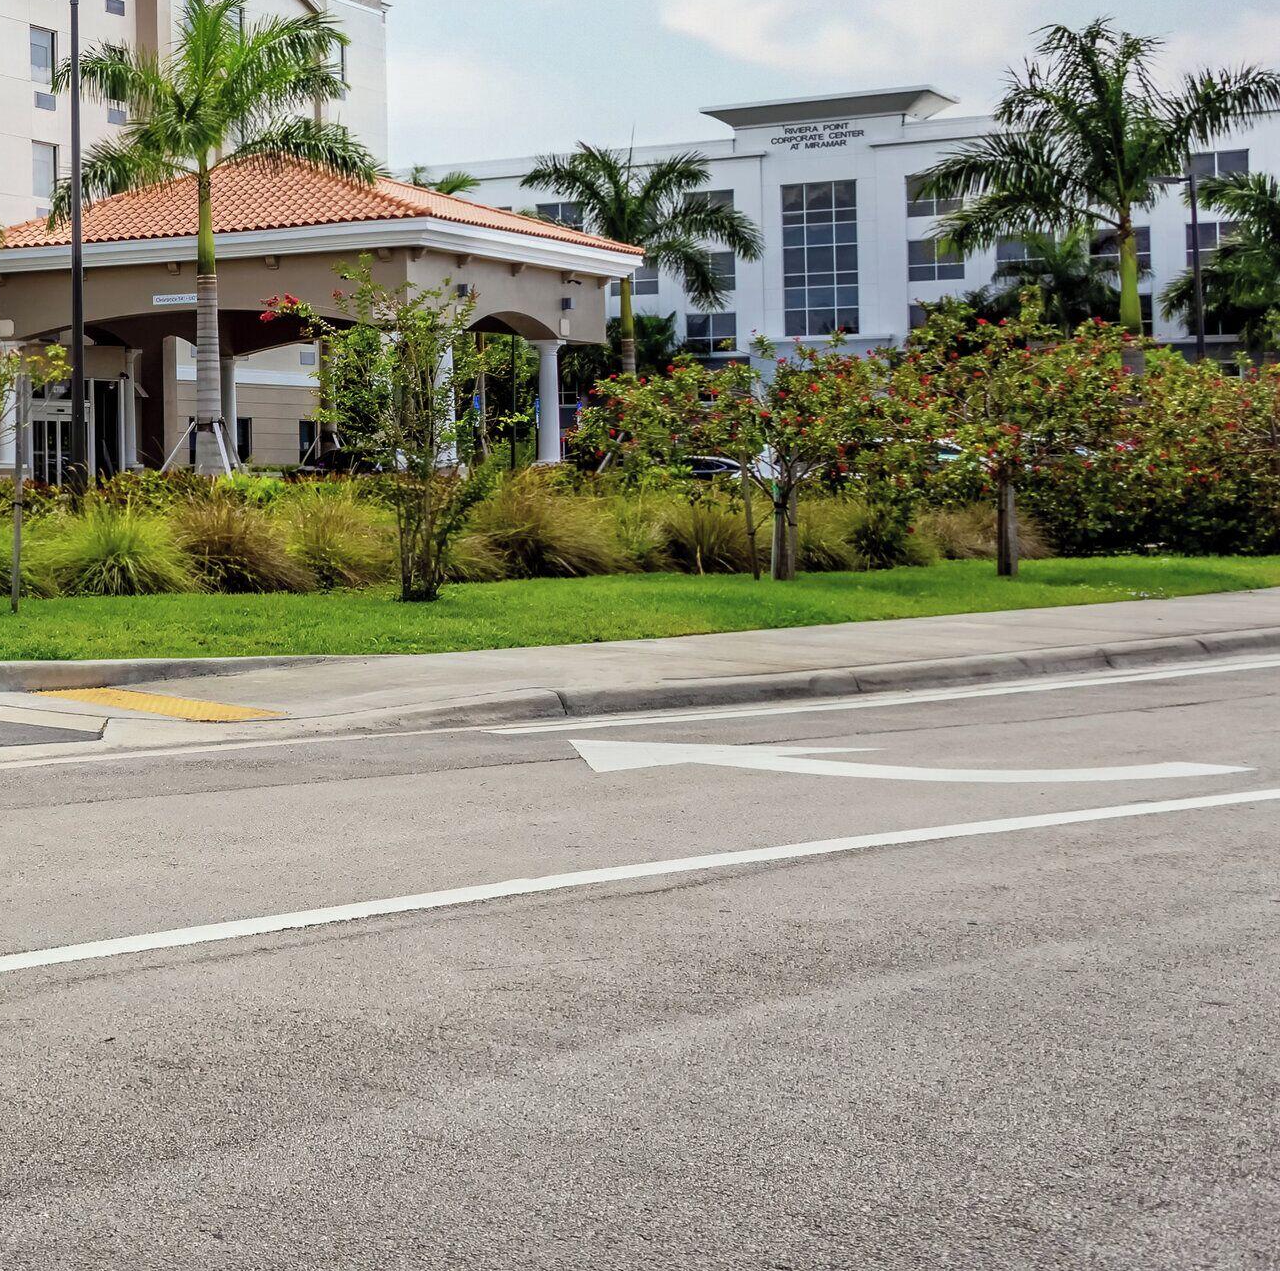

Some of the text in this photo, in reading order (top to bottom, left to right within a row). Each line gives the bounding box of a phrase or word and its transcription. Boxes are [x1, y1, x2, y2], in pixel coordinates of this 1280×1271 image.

[784, 122, 849, 135] RIVIERA POINT
[770, 129, 865, 145] CORPORATE CENTER
[804, 139, 847, 149] MIRAMAR
